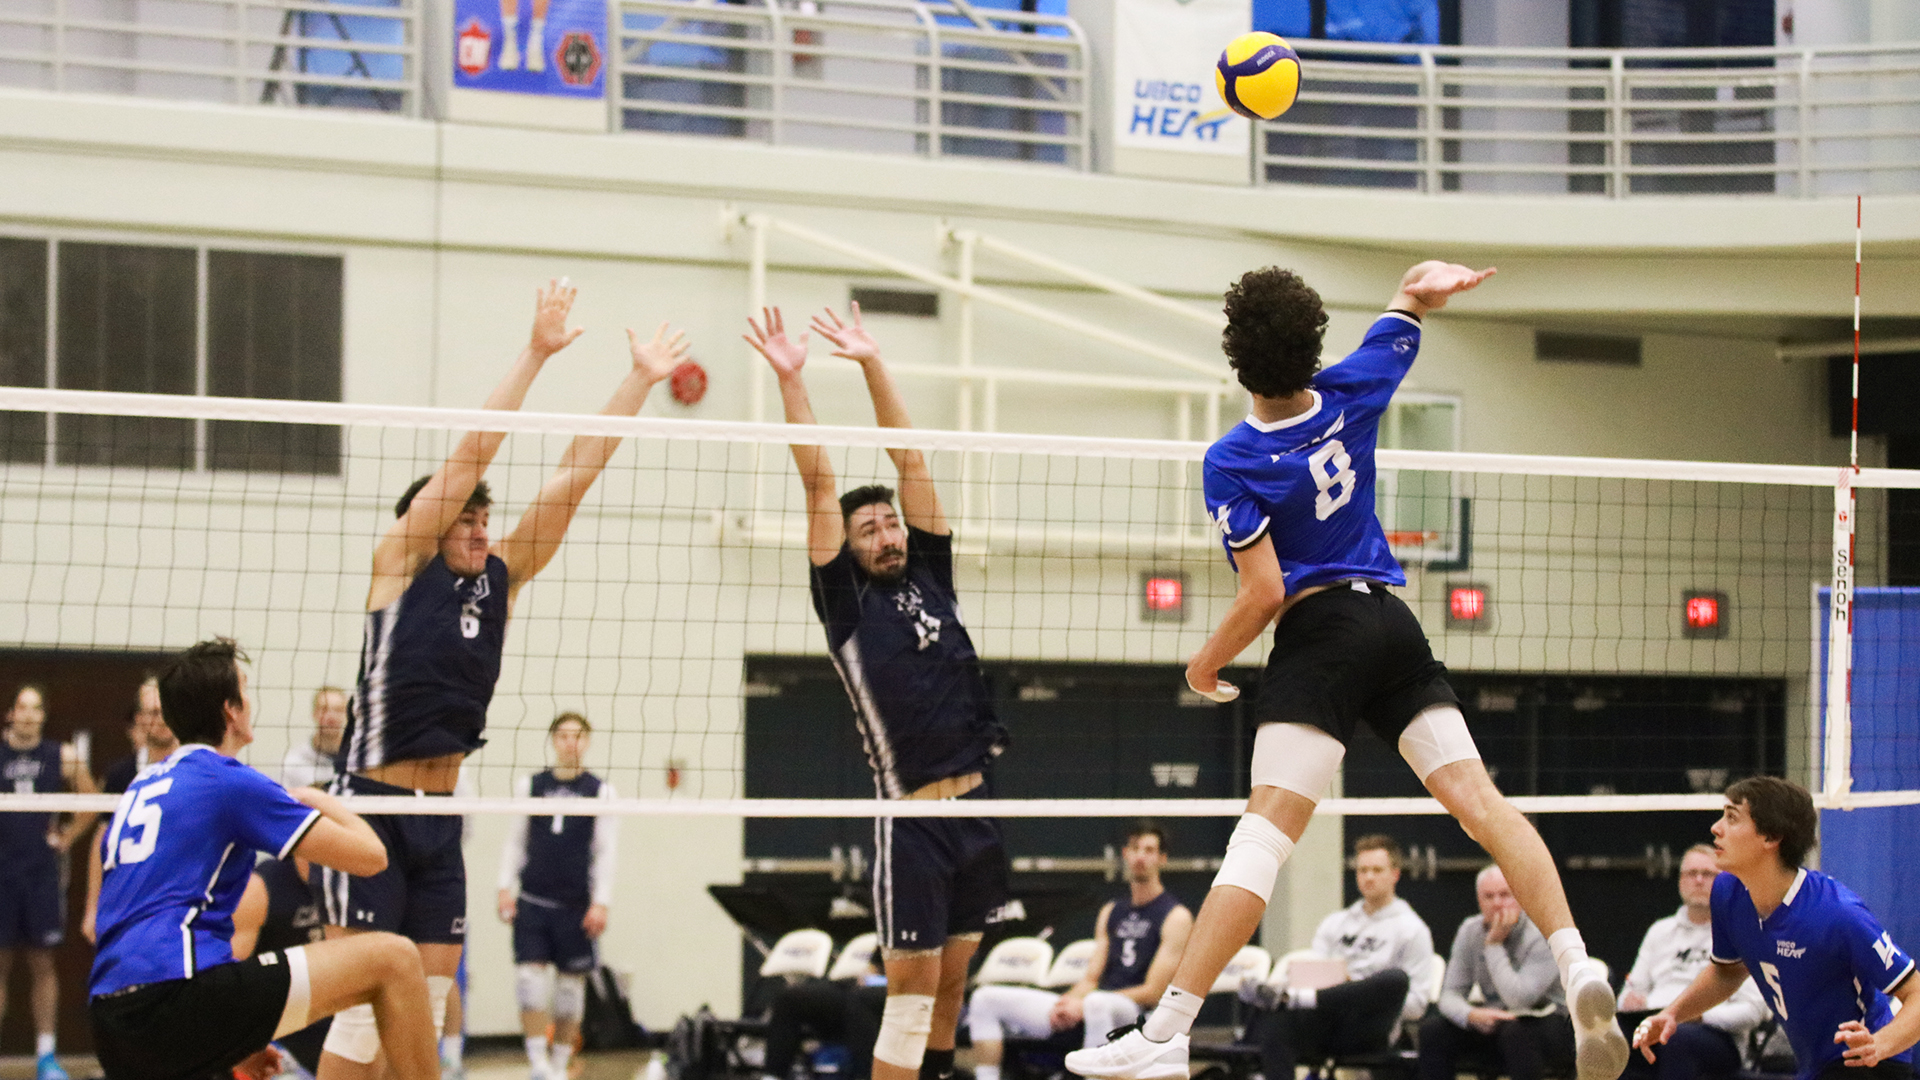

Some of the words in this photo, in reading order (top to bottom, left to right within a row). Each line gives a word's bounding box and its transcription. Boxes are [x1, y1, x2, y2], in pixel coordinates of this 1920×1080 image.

[1133, 79, 1202, 103] UBCO
[1308, 439, 1357, 521] 8
[1835, 549, 1848, 621] Senoh
[460, 603, 482, 639] 6
[103, 777, 174, 871] 15
[1121, 939, 1137, 967] 5
[1776, 939, 1796, 950] UBCO
[1758, 960, 1789, 1022] 5
